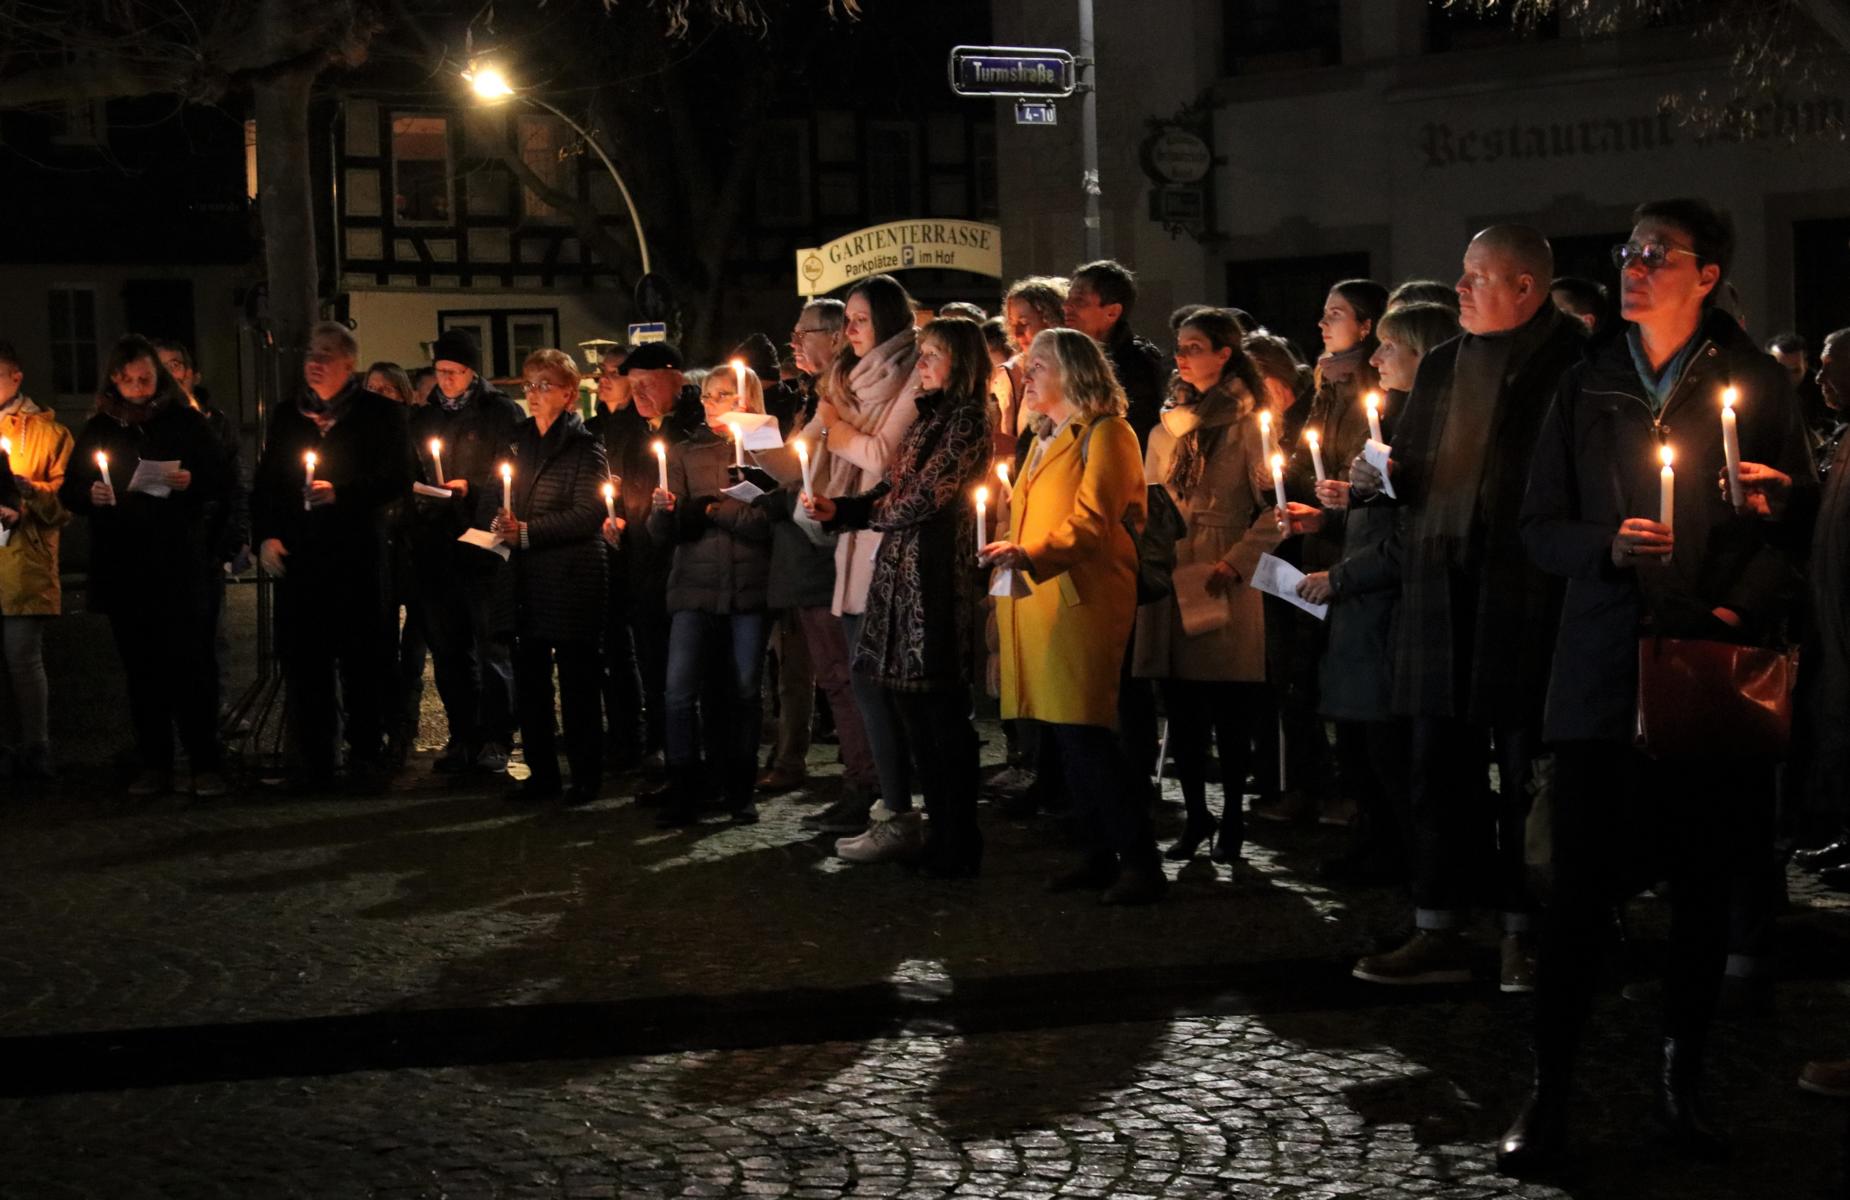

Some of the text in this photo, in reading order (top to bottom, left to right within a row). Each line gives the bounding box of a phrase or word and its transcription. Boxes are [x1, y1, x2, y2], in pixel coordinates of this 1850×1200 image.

[972, 61, 1055, 85] Turmstraße
[1024, 107, 1055, 122] 4-10
[1420, 108, 1675, 167] Restaurant
[829, 224, 992, 264] GARTENTERRASSE
[846, 253, 898, 277] Parkplätze
[919, 251, 932, 263] im
[936, 250, 955, 264] Hof
